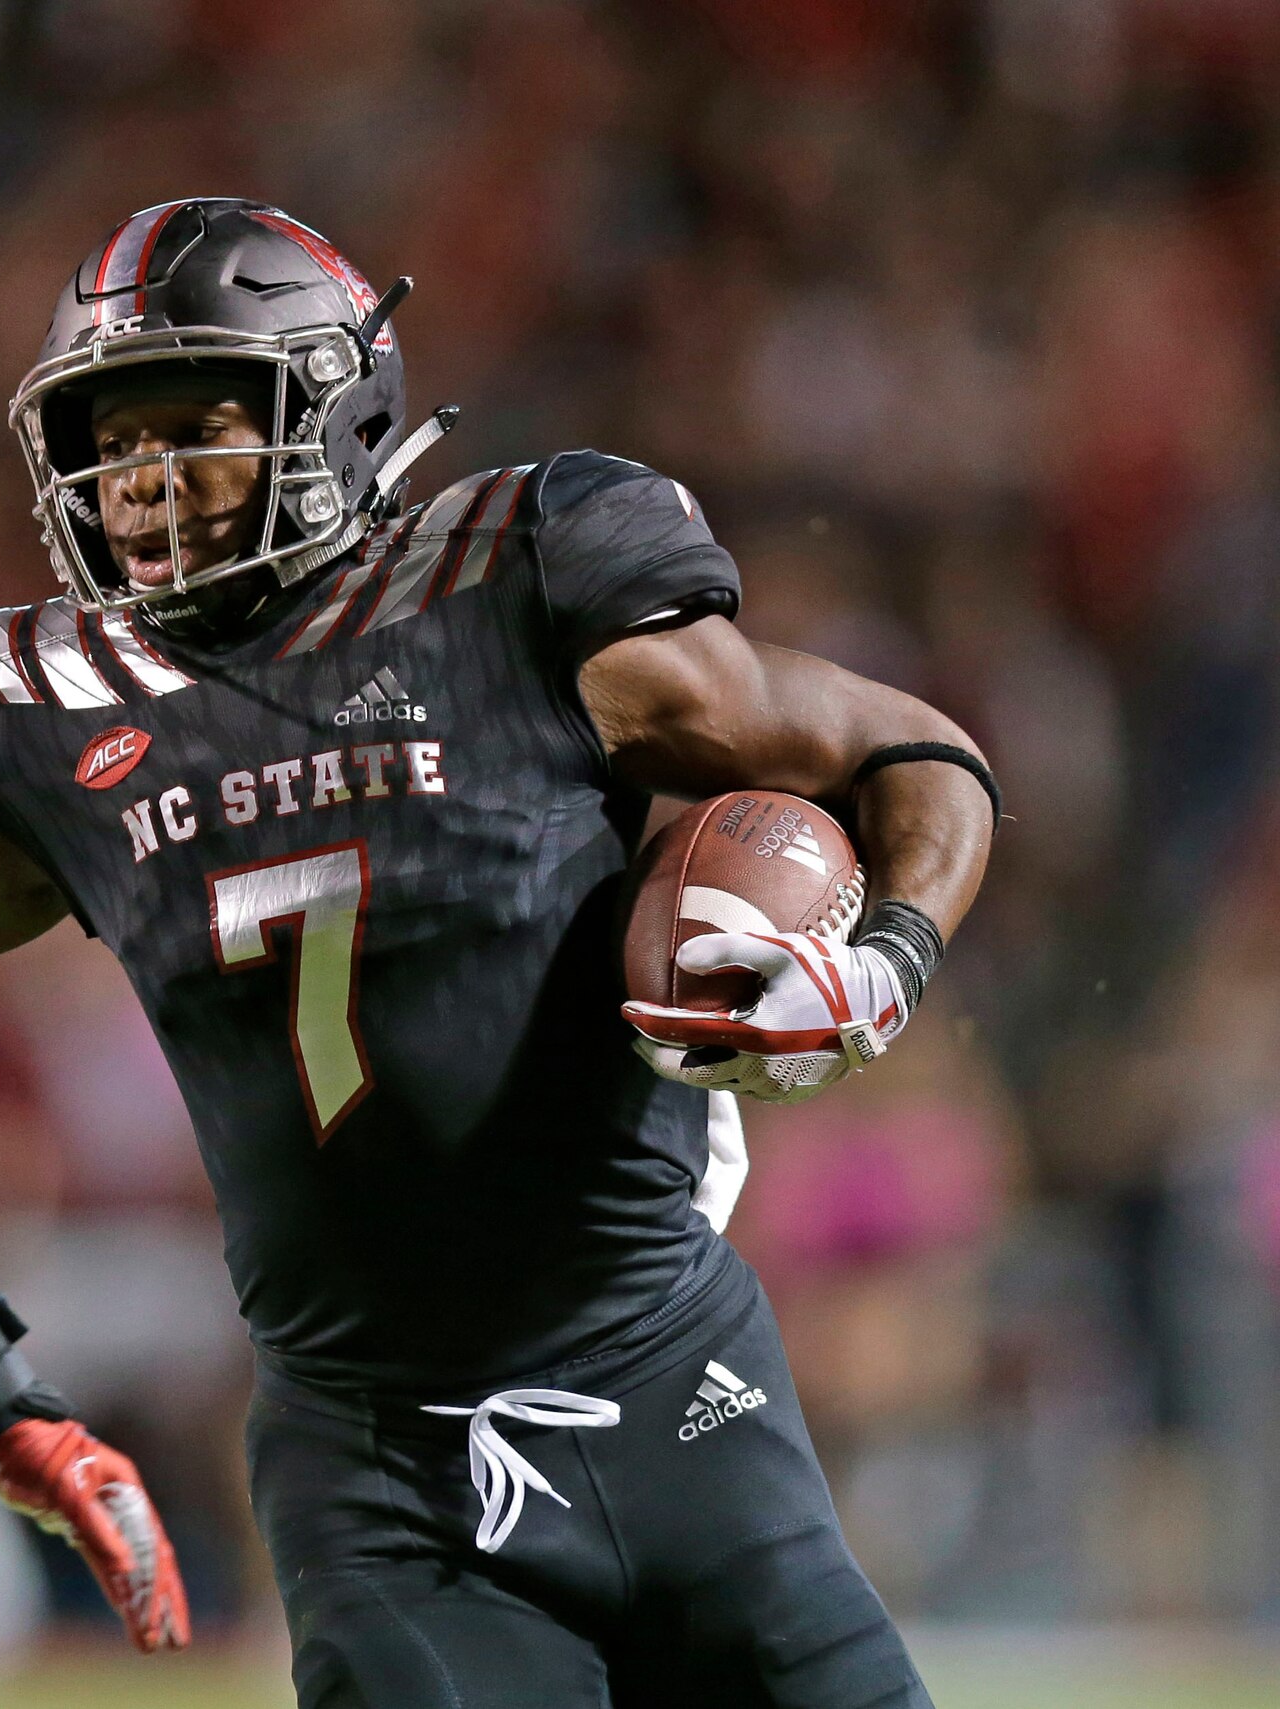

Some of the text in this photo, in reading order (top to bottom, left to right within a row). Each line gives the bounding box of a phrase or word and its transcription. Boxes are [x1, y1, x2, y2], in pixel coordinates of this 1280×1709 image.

[86, 314, 145, 345] ACC
[333, 702, 428, 726] adidas
[86, 731, 137, 779] ACC
[120, 739, 449, 864] NC STATE
[716, 796, 758, 838] DIME
[754, 807, 803, 860] adidas
[204, 838, 375, 1149] 7
[678, 1387, 768, 1441] adidas
